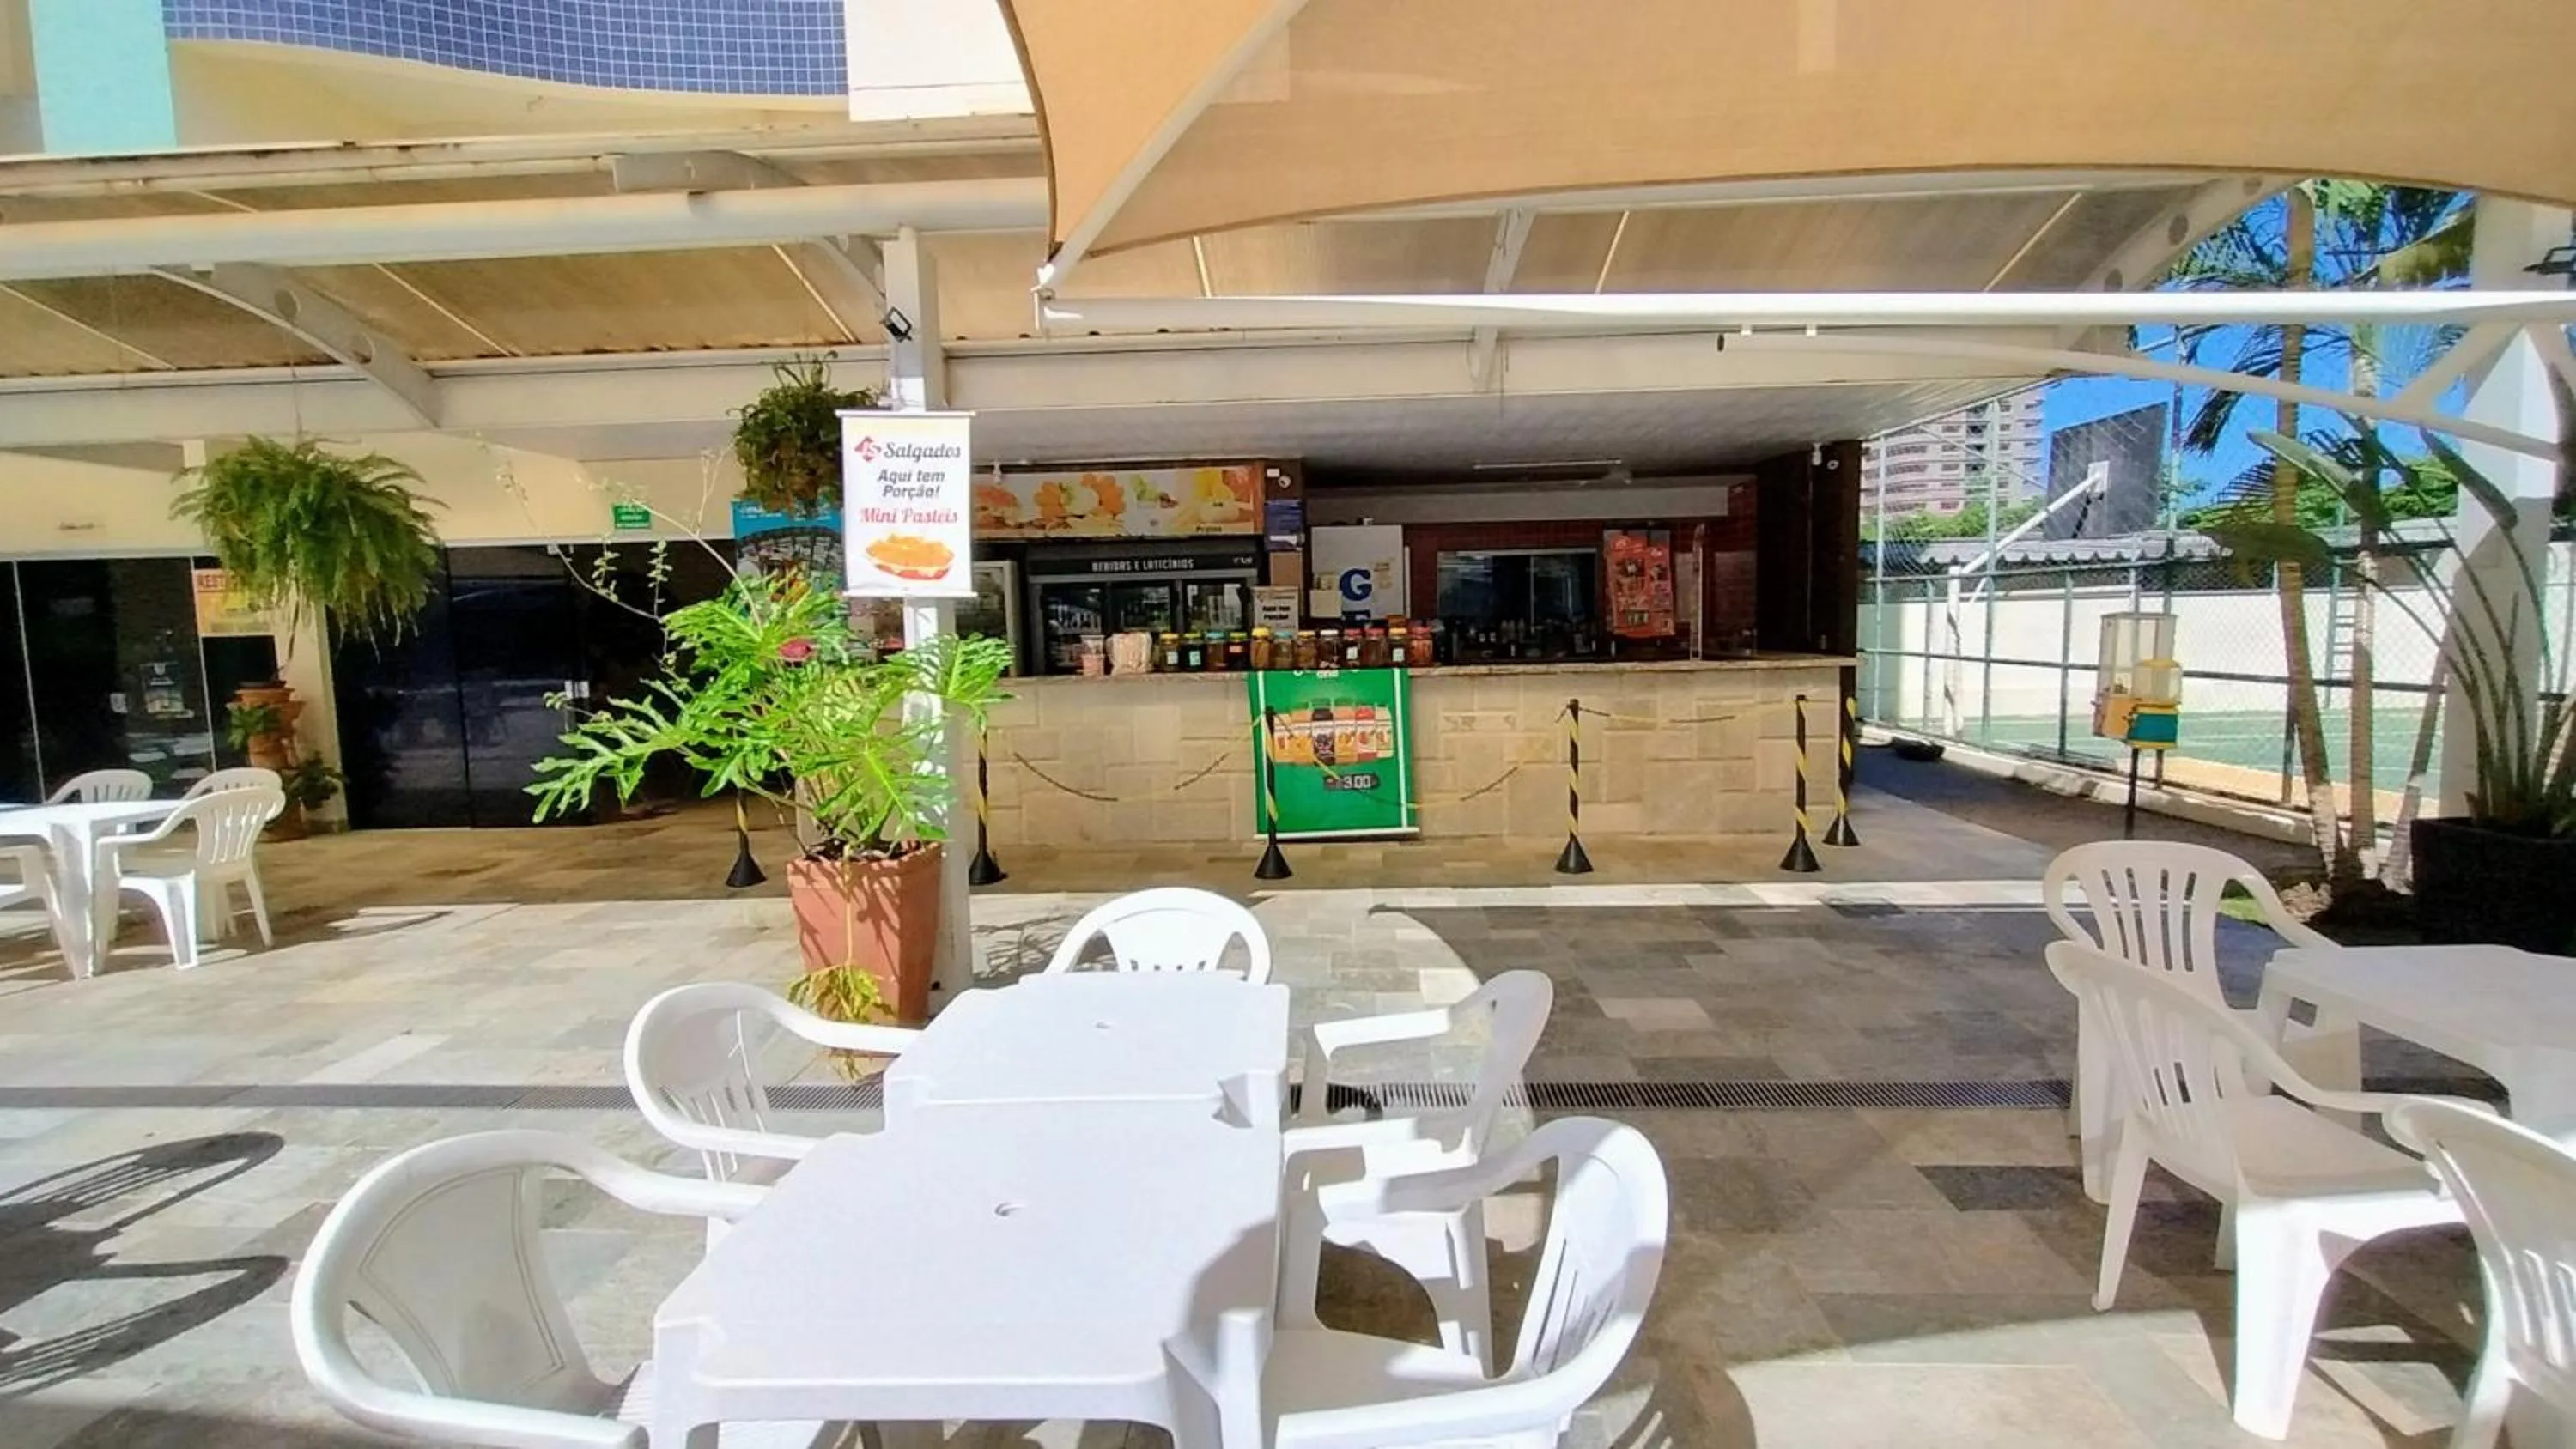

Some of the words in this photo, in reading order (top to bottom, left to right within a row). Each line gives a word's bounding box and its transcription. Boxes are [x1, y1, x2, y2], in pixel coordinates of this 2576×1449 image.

[884, 442, 961, 463] Salgados
[877, 469, 912, 484] Aqui
[917, 470, 945, 482] tem
[882, 484, 940, 501] Porção!
[860, 507, 897, 523] Mini
